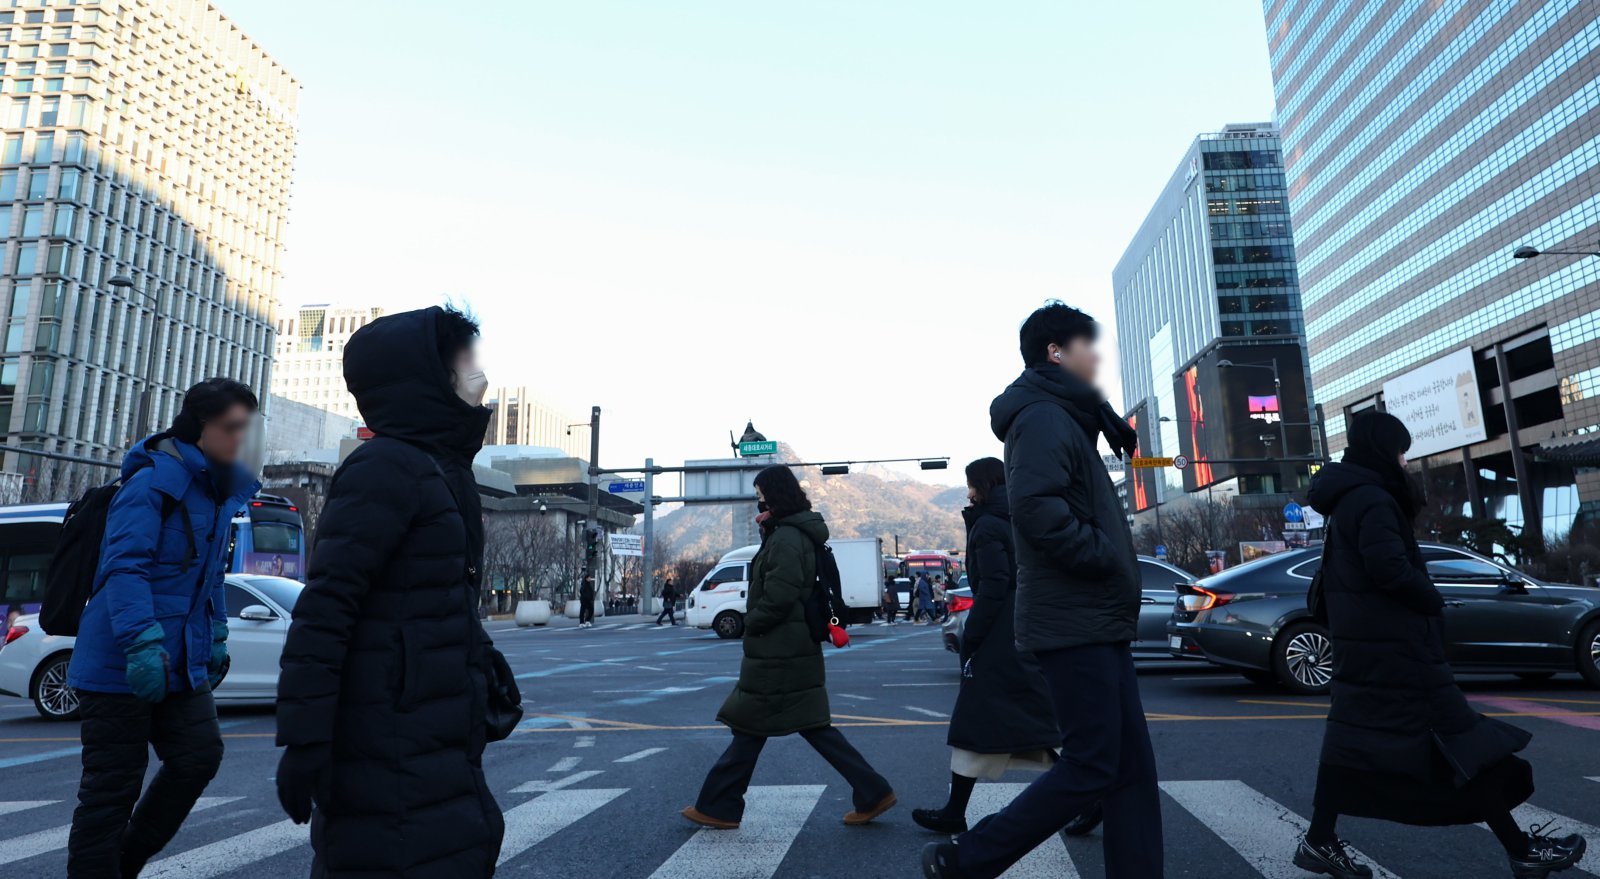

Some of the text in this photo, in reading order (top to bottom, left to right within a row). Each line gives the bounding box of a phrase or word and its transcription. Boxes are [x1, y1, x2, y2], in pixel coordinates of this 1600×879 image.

[1432, 377, 1454, 394] 궁금합니다
[744, 444, 772, 452] 세종대로사거리
[1177, 458, 1186, 467] 50
[1540, 848, 1553, 861] N
